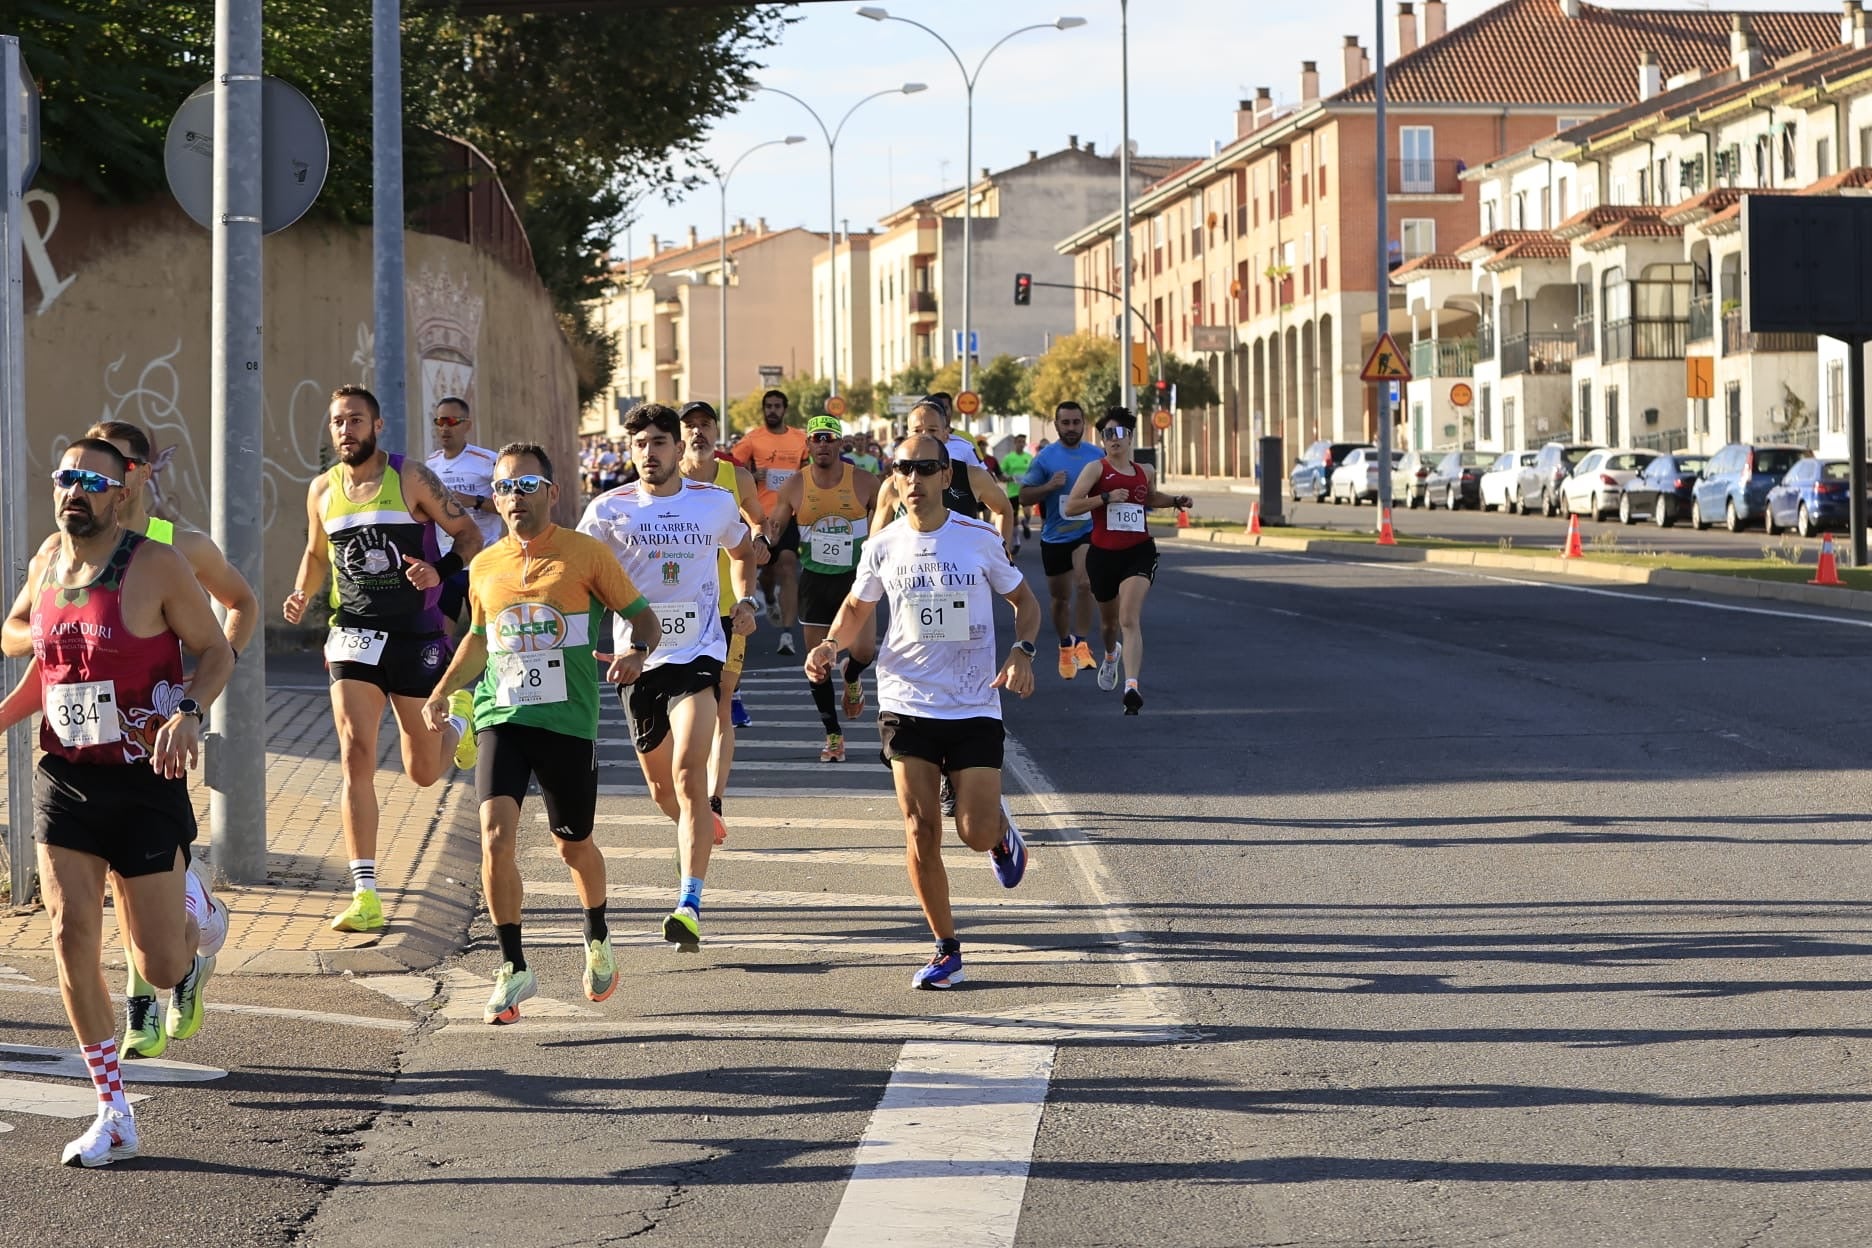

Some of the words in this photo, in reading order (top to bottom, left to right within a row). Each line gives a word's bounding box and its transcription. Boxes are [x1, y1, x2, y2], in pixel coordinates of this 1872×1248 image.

[1117, 511, 1138, 523] 180
[640, 523, 651, 532] III
[654, 522, 700, 533] CARRERA
[823, 543, 840, 556] 26
[897, 566, 907, 576] III
[911, 561, 958, 574] CARRERA
[887, 575, 936, 591] VARDIA
[940, 573, 976, 586] CIVIL
[920, 607, 943, 626] 61
[50, 622, 79, 636] APIS
[500, 619, 559, 637] ALCER
[662, 617, 685, 634] 58
[517, 668, 541, 688] 18
[58, 702, 100, 726] 334
